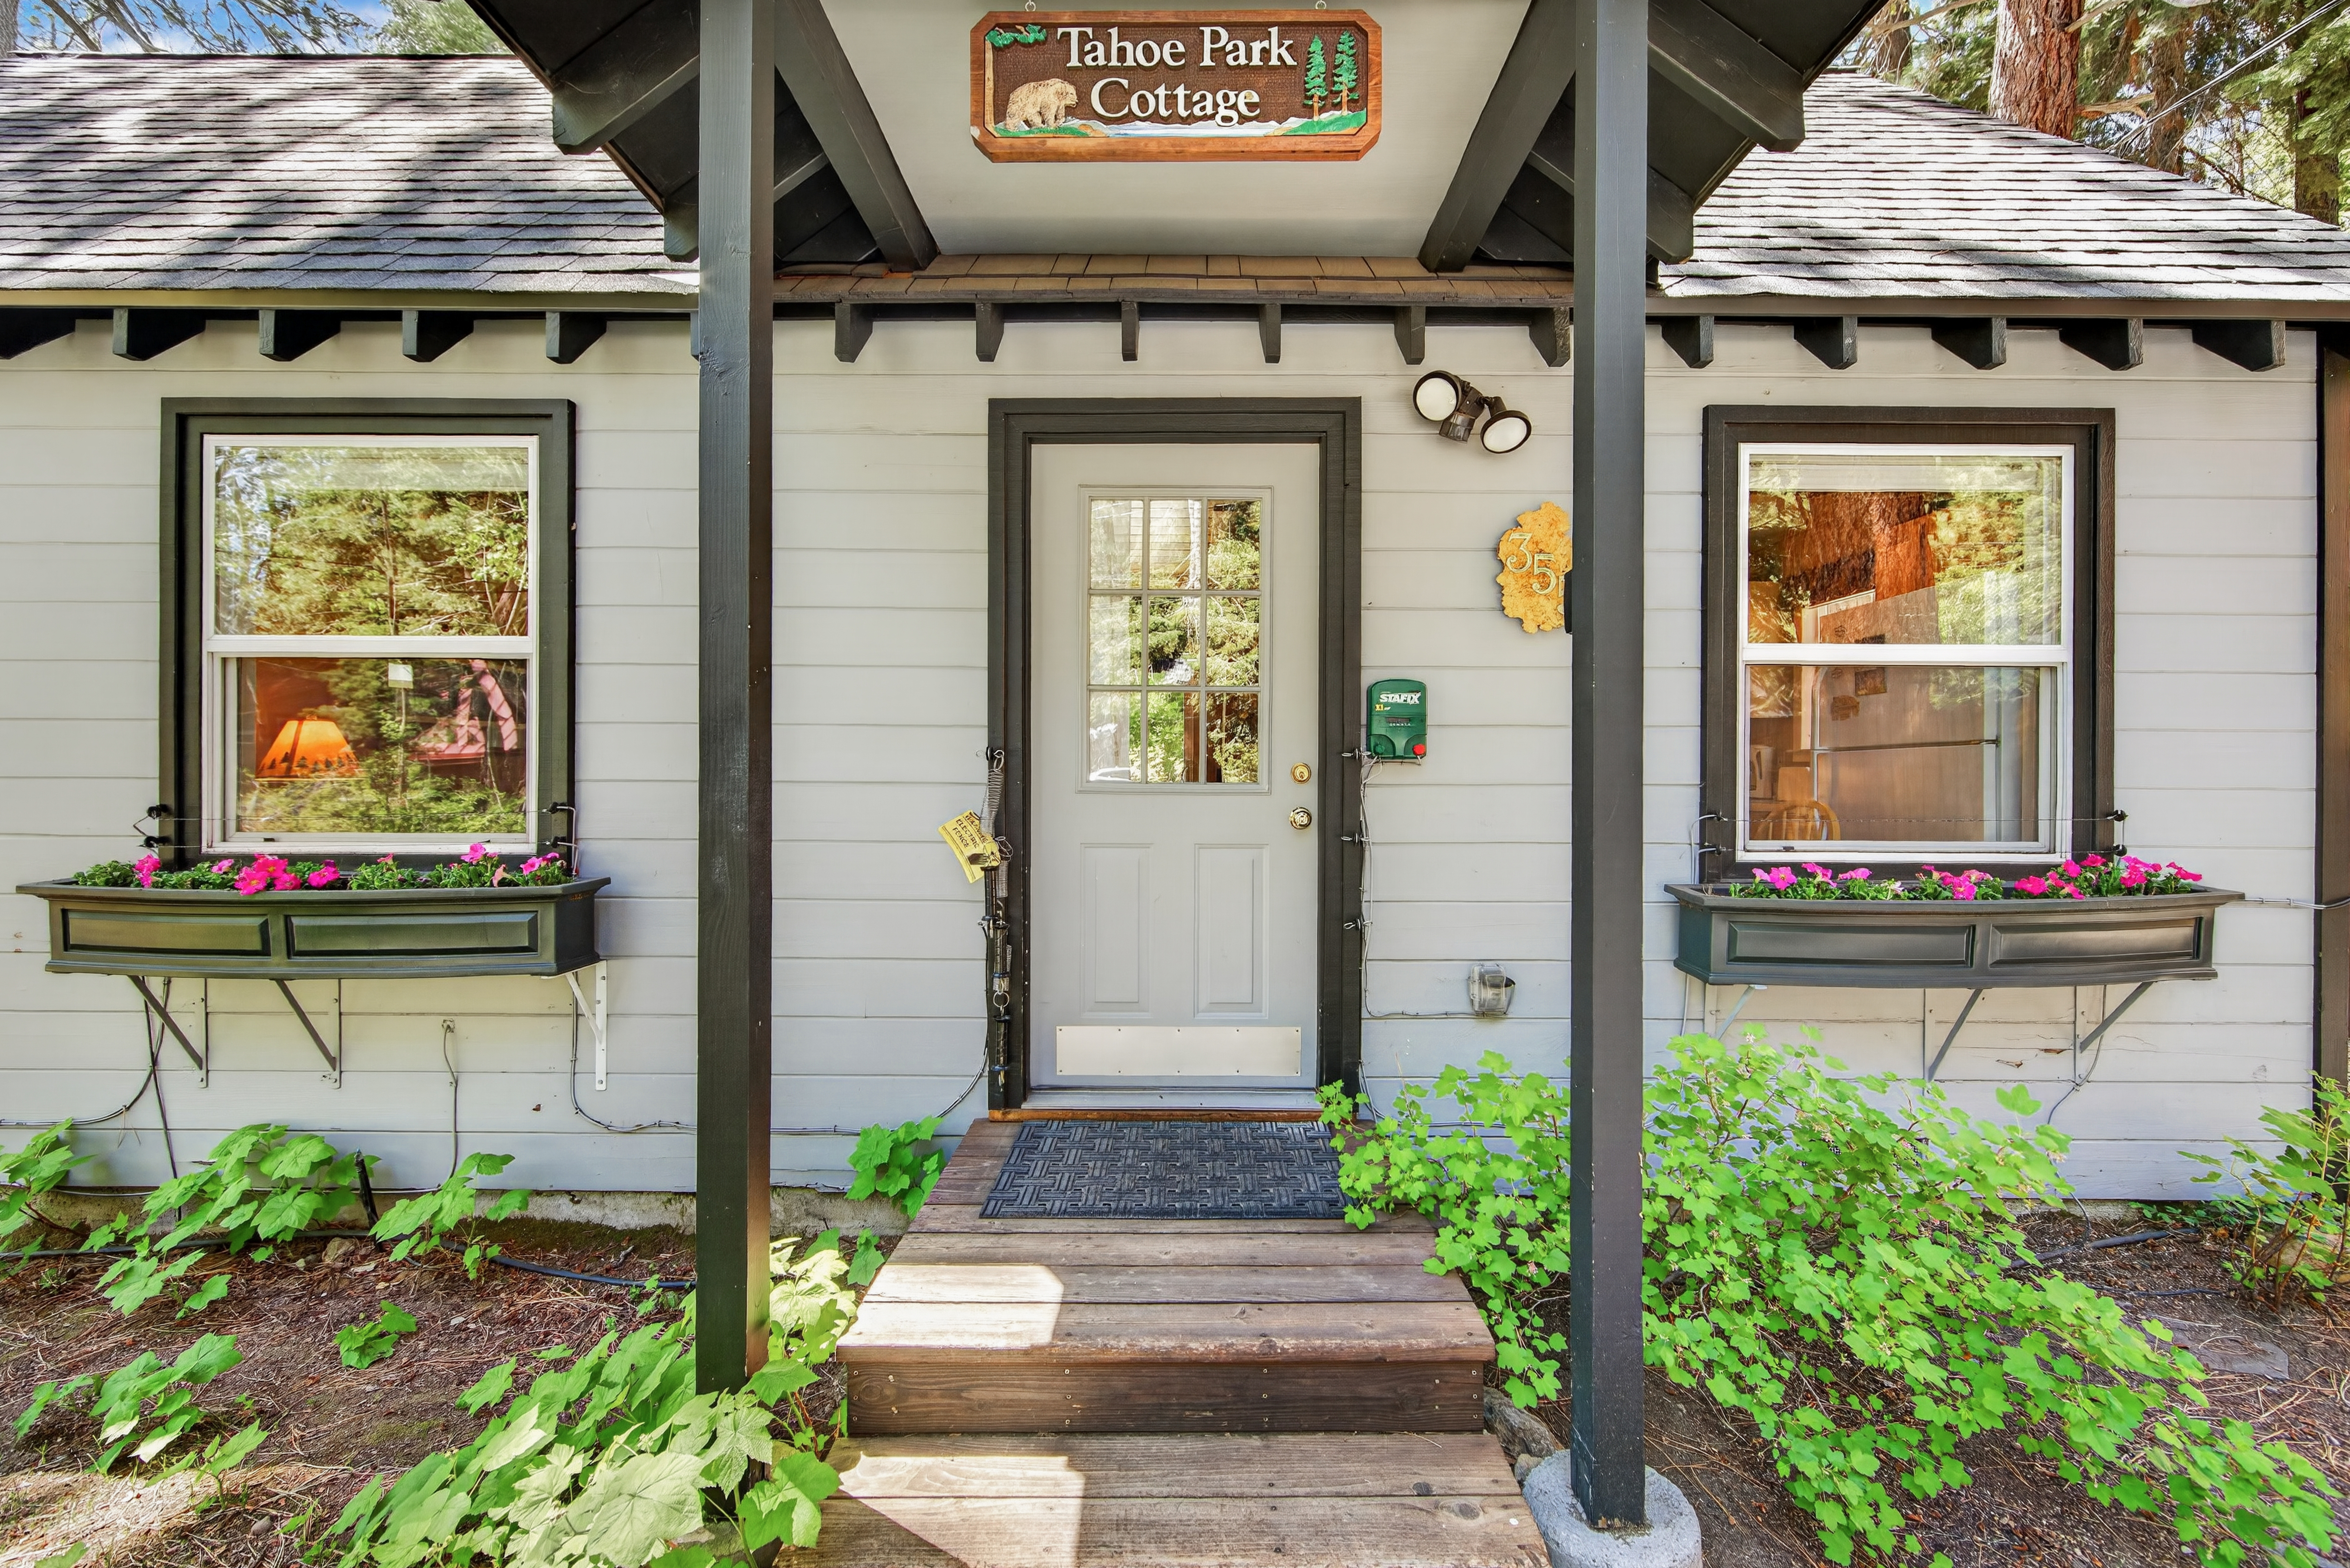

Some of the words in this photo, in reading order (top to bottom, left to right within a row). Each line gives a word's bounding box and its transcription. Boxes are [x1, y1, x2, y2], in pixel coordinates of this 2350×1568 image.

[1057, 26, 1186, 68] Tahoe
[1199, 26, 1297, 67] Park
[1090, 78, 1261, 127] Cottage
[1506, 532, 1564, 614] 35
[1379, 692, 1421, 705] STAFIX
